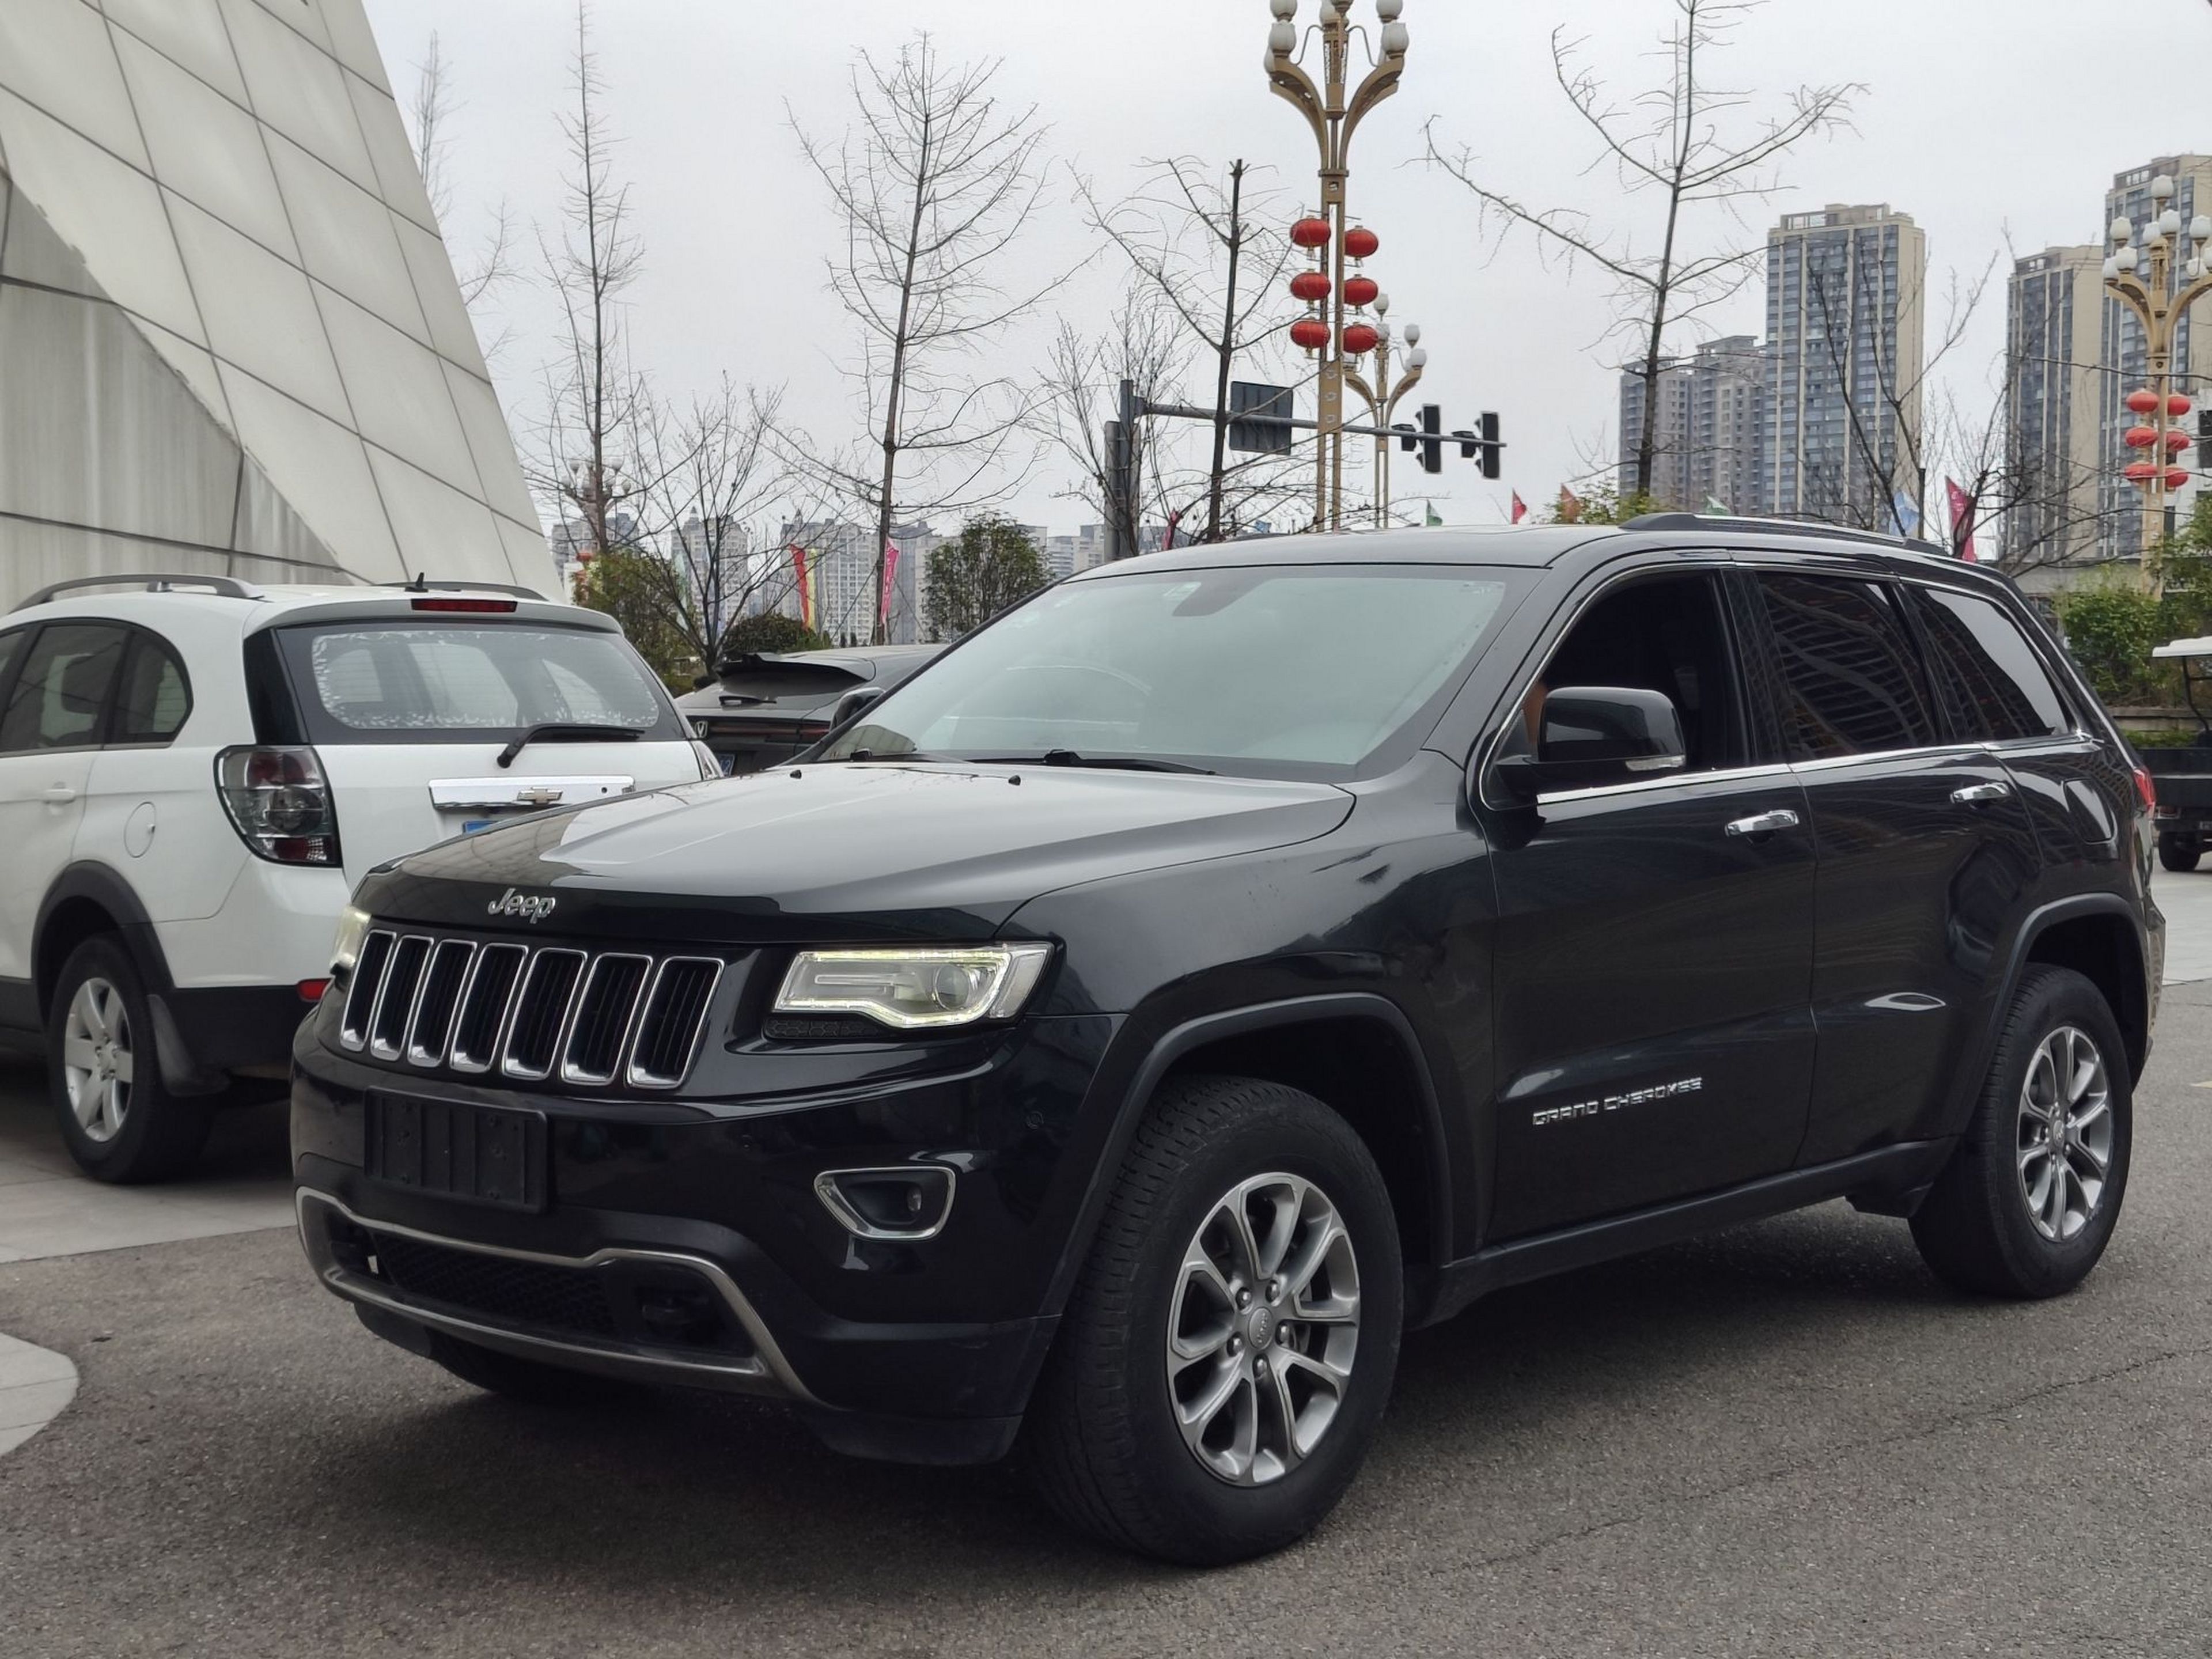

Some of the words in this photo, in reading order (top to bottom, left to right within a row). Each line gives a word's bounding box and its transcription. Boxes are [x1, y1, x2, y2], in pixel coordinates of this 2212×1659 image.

[488, 888, 556, 924] Jeep
[1533, 1101, 1599, 1125] GRAND
[1604, 1077, 1702, 1110] CHEROKEE
